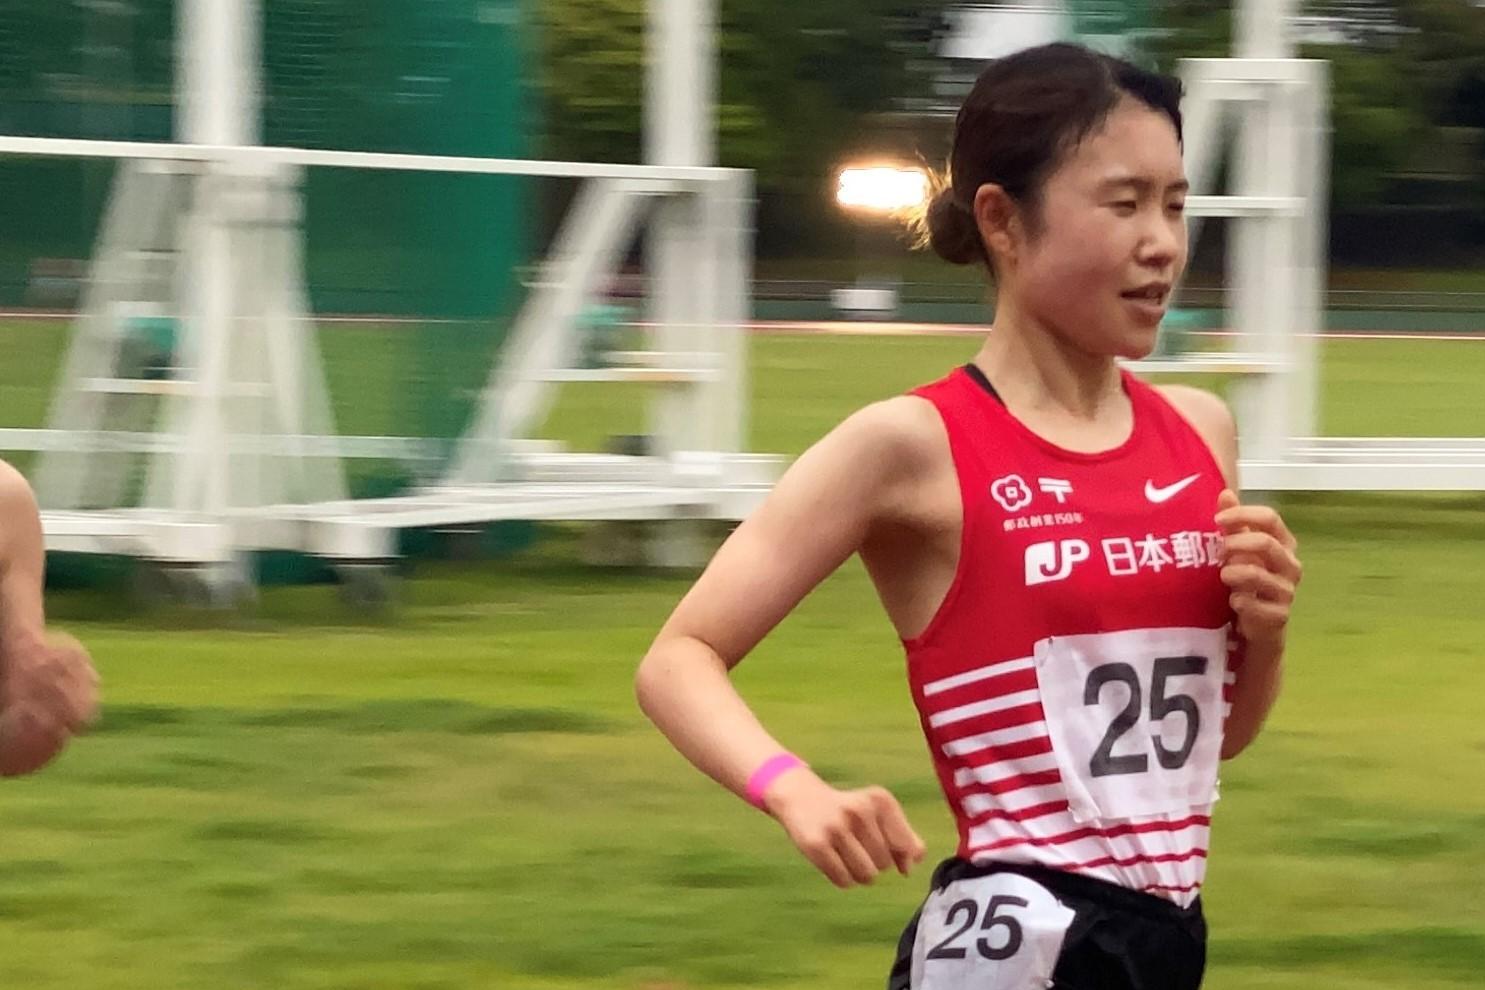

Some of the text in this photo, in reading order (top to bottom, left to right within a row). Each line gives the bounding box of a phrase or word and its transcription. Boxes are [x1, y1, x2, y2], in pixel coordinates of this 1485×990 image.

[1024, 539, 1090, 586] JP
[1083, 656, 1208, 778] 25
[926, 894, 1029, 961] 25
